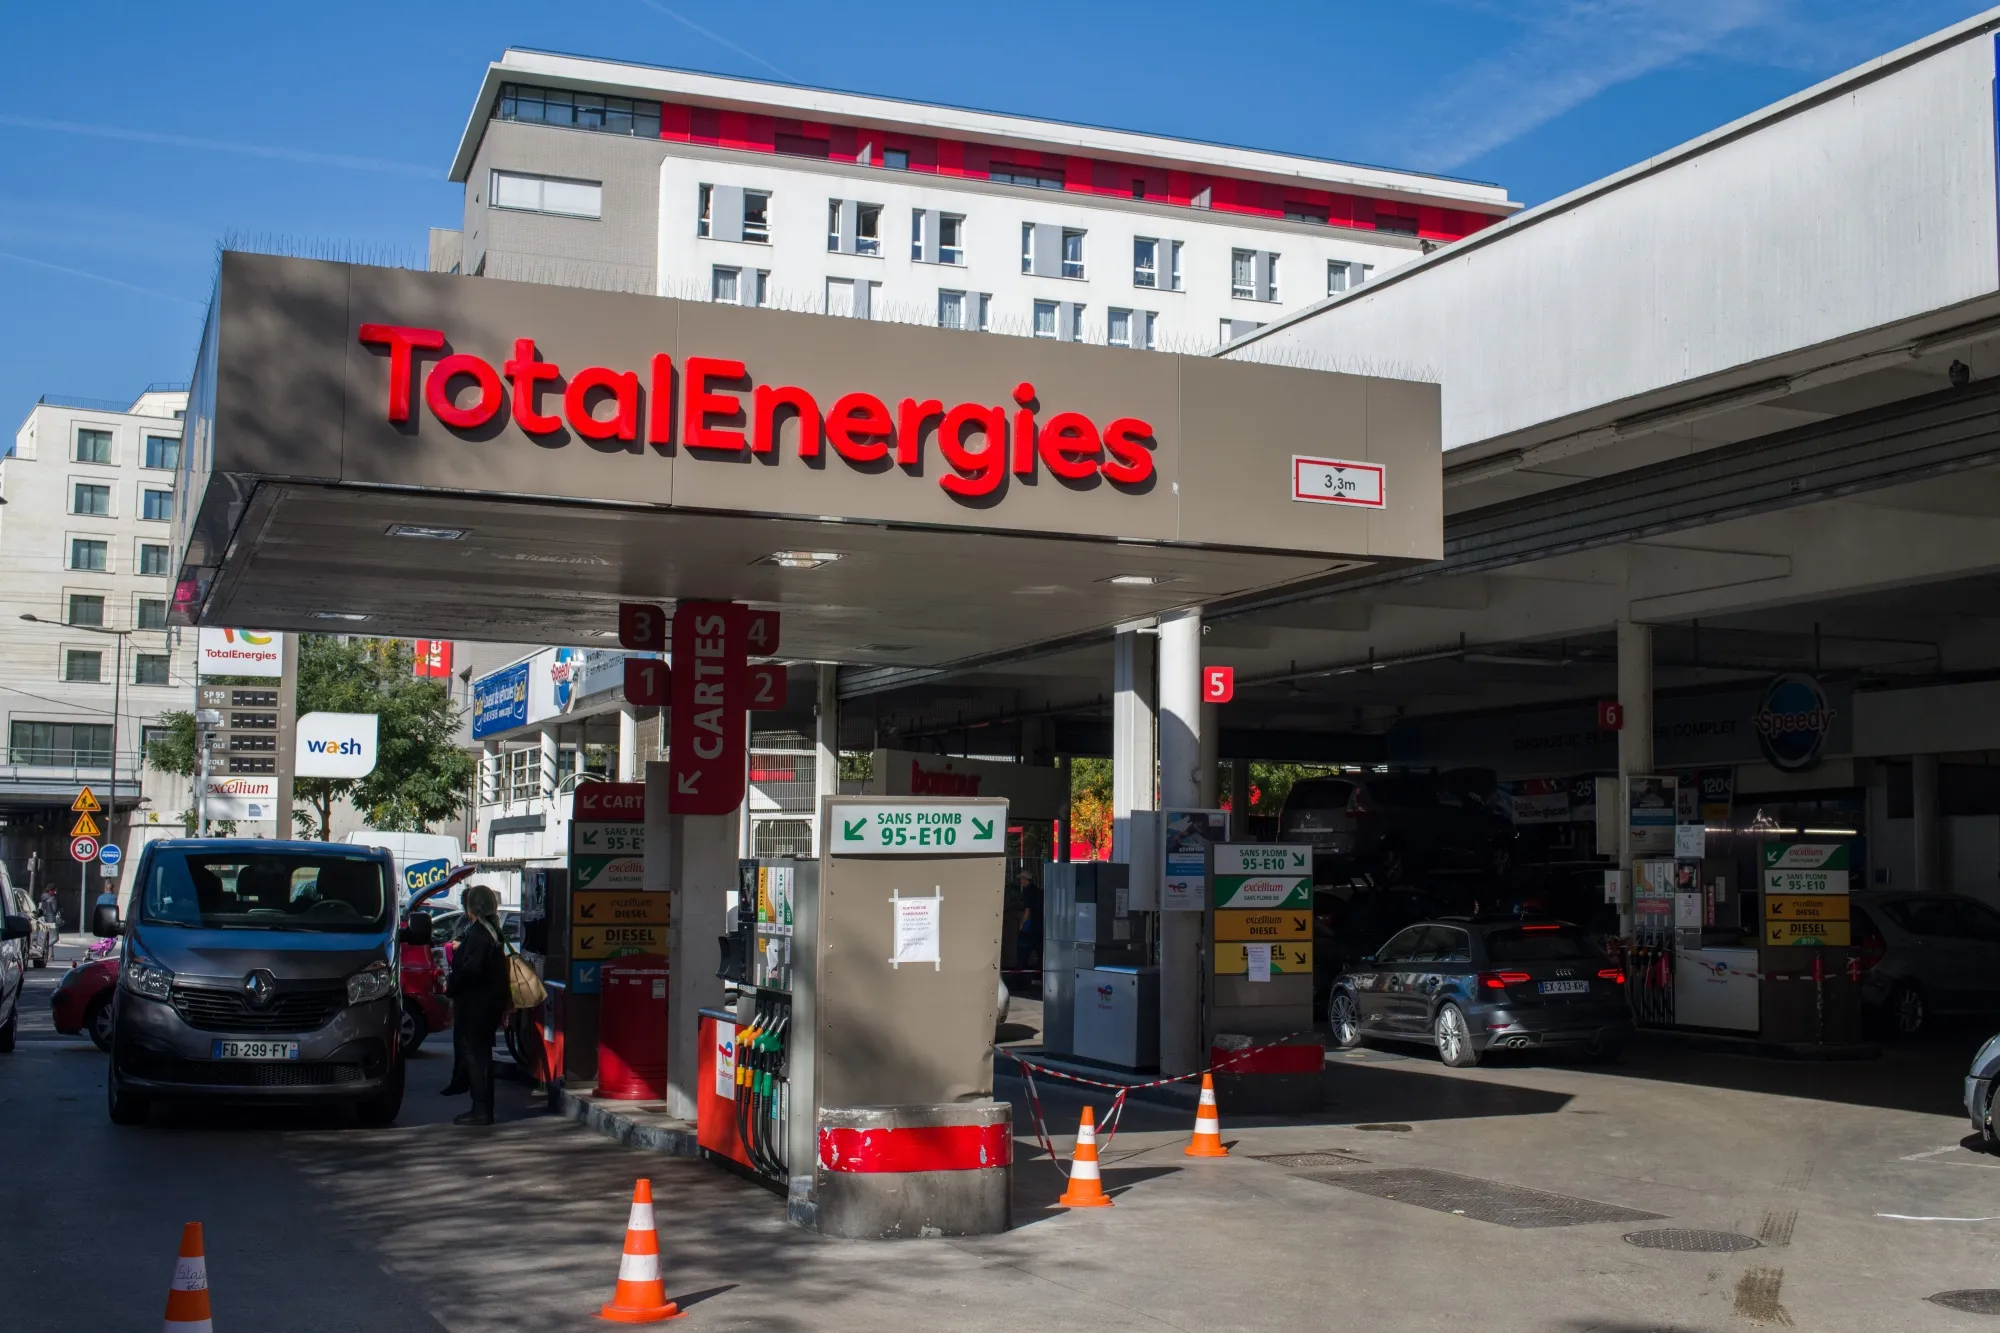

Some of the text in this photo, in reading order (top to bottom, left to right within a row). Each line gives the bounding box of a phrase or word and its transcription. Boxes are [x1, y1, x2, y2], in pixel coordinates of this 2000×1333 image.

[358, 323, 1154, 497] TotalEnergies
[1324, 474, 1356, 491] 3,3m
[633, 612, 652, 642] 3
[748, 618, 767, 647] 4
[205, 648, 277, 661] TotalEnergies
[640, 667, 654, 697] 1
[693, 615, 725, 760] CARTES
[754, 672, 775, 702] 2
[1211, 672, 1225, 697] 5
[1606, 706, 1617, 724] 6
[1753, 705, 1837, 738] Speedy
[1673, 720, 1737, 738] COMPLET
[307, 737, 362, 755] wash
[206, 780, 269, 794] excellium
[603, 795, 646, 809] CART
[877, 813, 962, 825] SANS PLOMB
[881, 827, 957, 846] 95-E10
[77, 843, 93, 854] 30
[1240, 849, 1288, 857] SANS PLOMB
[1242, 858, 1285, 870] 95-E10
[1244, 882, 1283, 892] excellium
[1789, 881, 1826, 890] 95-E10
[615, 910, 648, 918] DIESEL
[1245, 915, 1282, 924] excellium
[606, 929, 655, 941] DIESEL
[1250, 926, 1278, 935] DIESEL
[1790, 923, 1826, 933] DIESEL
[223, 1043, 288, 1057] FD-299-FY
